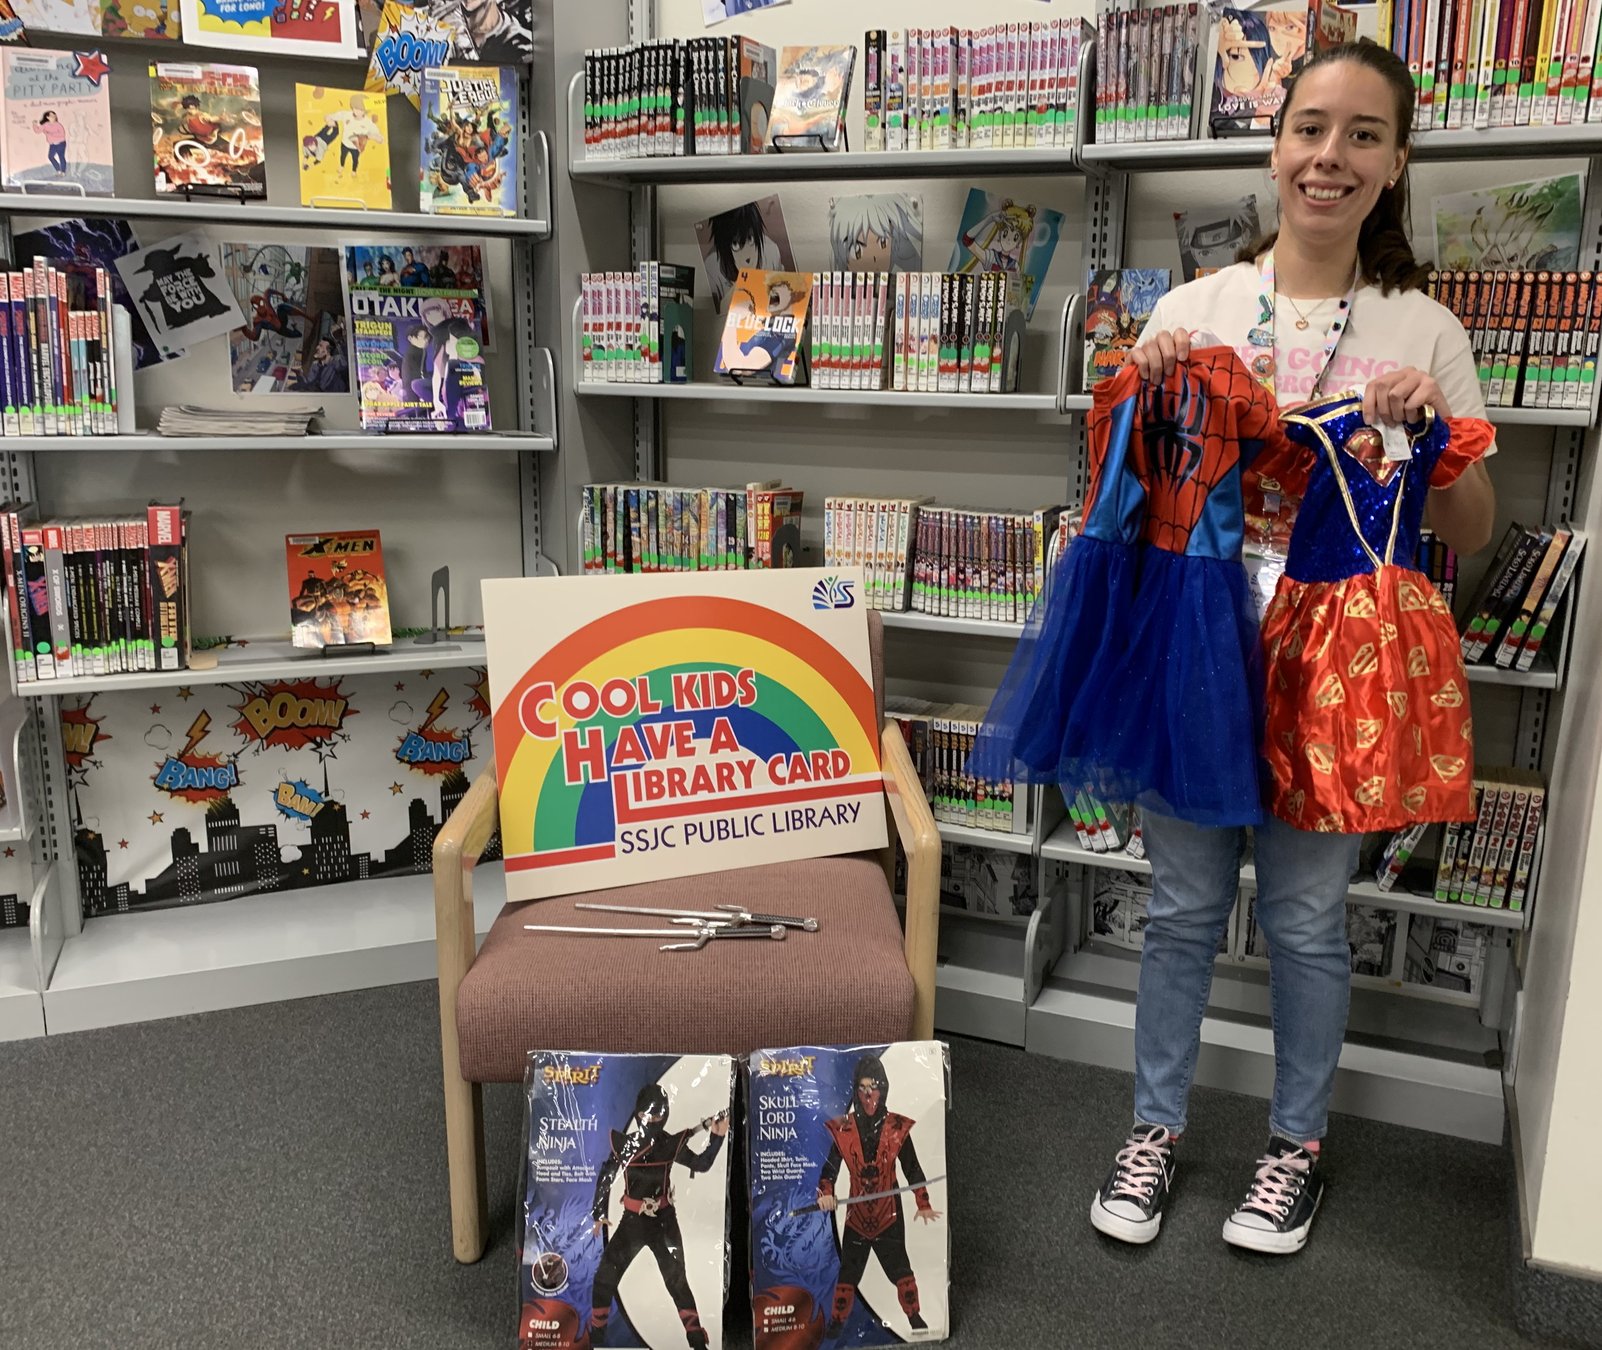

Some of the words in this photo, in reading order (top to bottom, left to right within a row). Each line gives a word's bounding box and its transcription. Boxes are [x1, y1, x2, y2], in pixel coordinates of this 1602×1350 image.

[220, 3, 238, 13] FOR
[239, 1, 265, 12] LONG!
[376, 31, 448, 81] BOOM!
[13, 85, 46, 97] PITY
[51, 82, 93, 95] PARTY
[441, 79, 497, 93] JUSTICE
[448, 88, 500, 104] LEAGUE
[1218, 102, 1245, 112] LOVE
[1249, 100, 1258, 109] IS
[156, 274, 173, 287] MAY
[174, 268, 194, 281] THE
[160, 276, 196, 297] FORCE
[176, 281, 202, 299] WITH
[167, 292, 206, 313] YOU
[354, 320, 392, 330] TRIGUN
[726, 312, 765, 331] BLUE
[764, 316, 799, 333] LOCK
[157, 511, 172, 545] MARVEL
[19, 597, 29, 628] ORIGINS
[518, 676, 663, 741] COOL
[671, 668, 758, 713] KIDS
[242, 692, 348, 738] BOOM!
[396, 732, 470, 764] BANG!
[562, 720, 697, 786] HAVE
[709, 716, 740, 756] A
[155, 757, 238, 792] BANG!
[611, 758, 757, 824] LIBRARY
[767, 748, 852, 786] CARD
[276, 781, 323, 818] BAM!
[620, 825, 676, 855] SSJC
[684, 814, 765, 846] PUBLIC
[772, 801, 861, 834] LIBRARY
[544, 1065, 602, 1084] SPIRIT
[760, 1056, 816, 1076] SPIRIT
[759, 1095, 799, 1110] SKULL
[540, 1117, 598, 1131] STEALTH
[760, 1111, 796, 1125] LORD
[760, 1126, 798, 1142] NINJA
[537, 1135, 576, 1153] NINJA
[764, 1305, 795, 1316] CHILD
[529, 1319, 560, 1330] CHILD
[771, 1325, 793, 1333] MEDIUM
